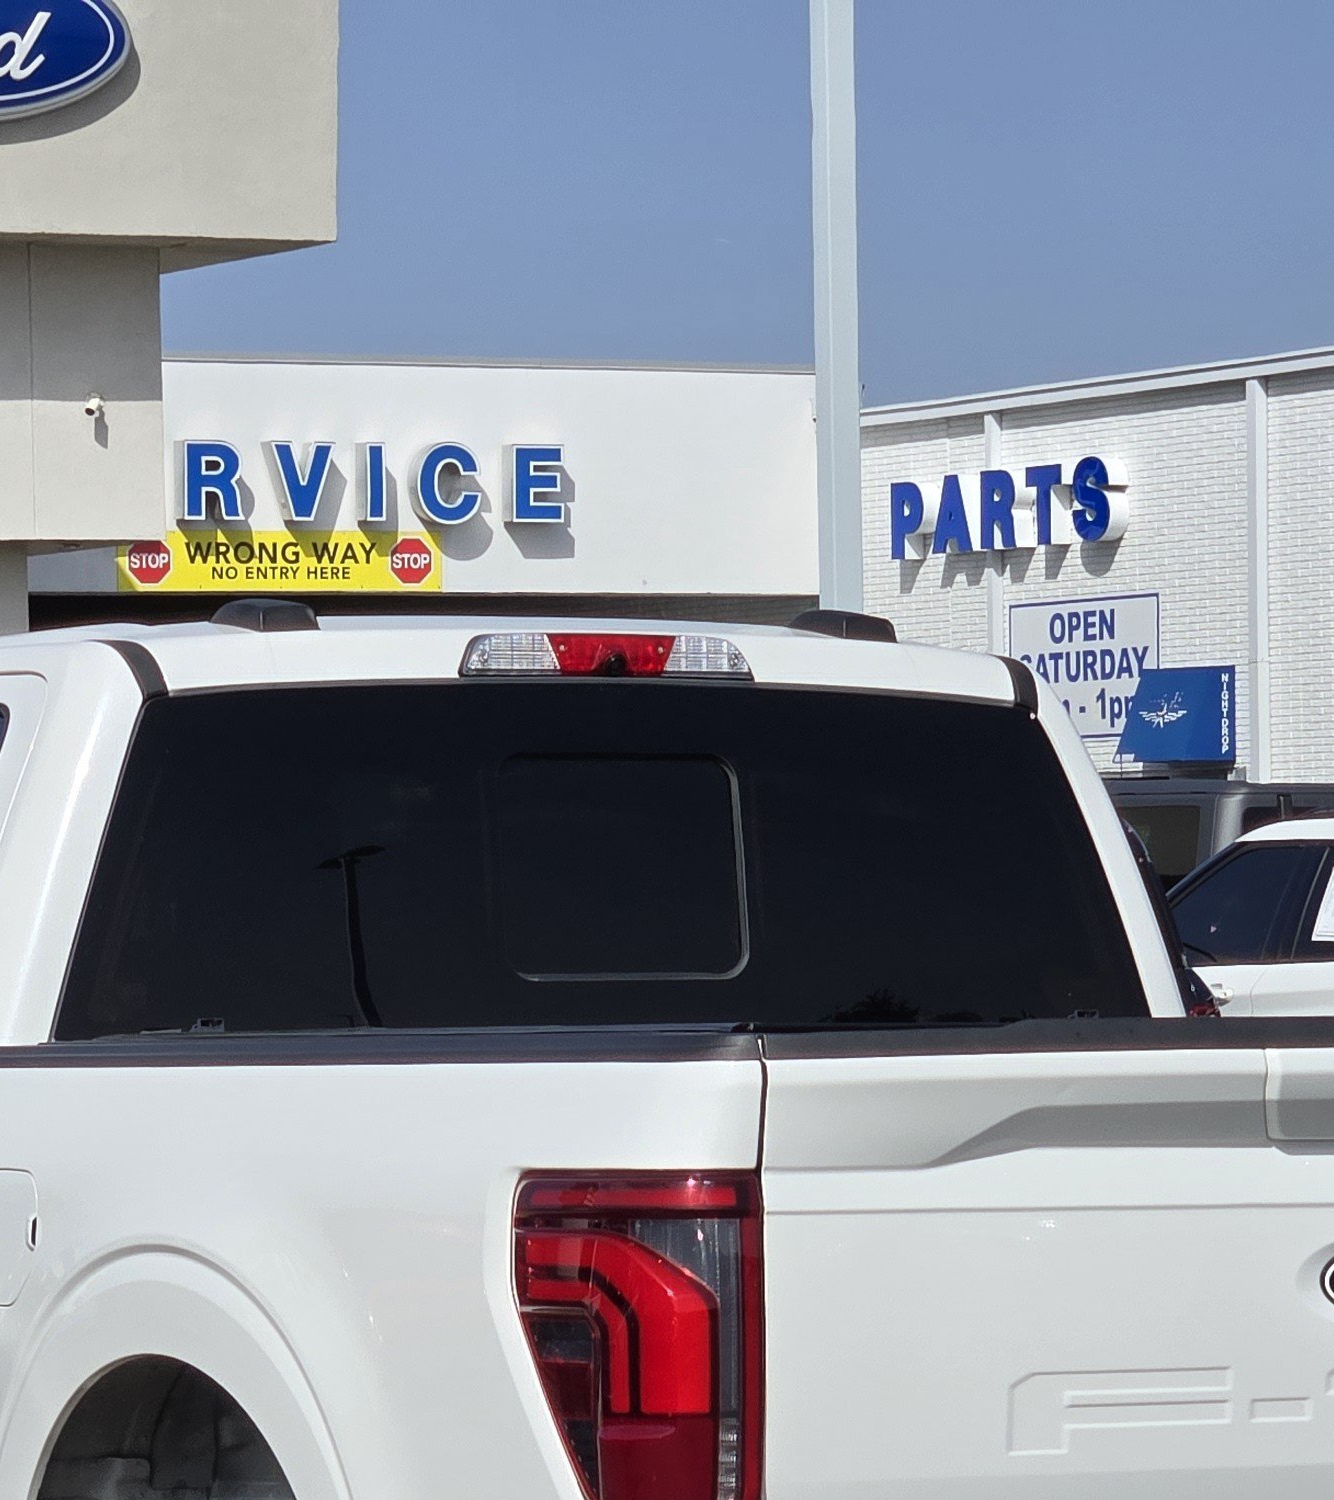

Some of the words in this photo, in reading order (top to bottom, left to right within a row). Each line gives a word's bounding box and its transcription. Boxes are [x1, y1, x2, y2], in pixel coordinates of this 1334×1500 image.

[891, 456, 1110, 560] PARTS
[129, 552, 170, 569] STOP
[185, 542, 301, 565] WRONG
[314, 542, 377, 565] WAY
[392, 552, 431, 570] STOP
[211, 566, 237, 581] NO
[246, 566, 300, 581] ENTRY
[307, 566, 352, 581] HERE
[1049, 608, 1116, 644] OPEN
[1221, 673, 1230, 718] NIGHT
[1221, 719, 1230, 754] DROP
